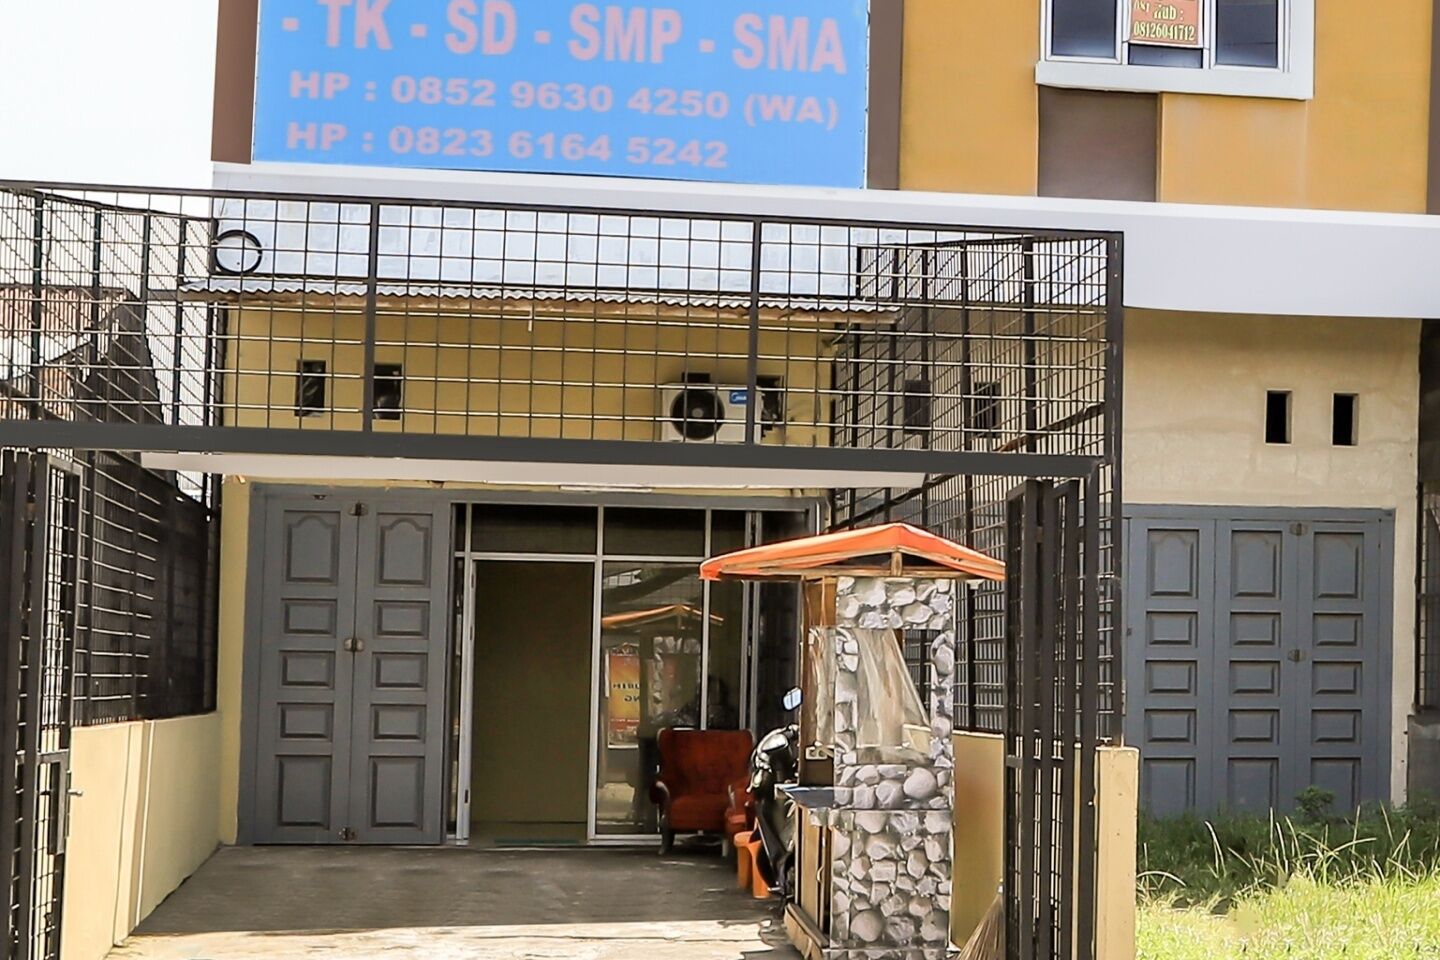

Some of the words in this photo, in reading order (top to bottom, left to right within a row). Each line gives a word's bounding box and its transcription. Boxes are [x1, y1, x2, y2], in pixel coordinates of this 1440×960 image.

[569, 2, 683, 64] SMP
[732, 14, 847, 73] SMA
[289, 70, 350, 100] HP
[391, 75, 496, 108] 0852
[511, 81, 612, 113] 9630
[628, 87, 729, 119] 4250
[743, 93, 838, 130] (WA)
[287, 122, 347, 151] HP
[389, 125, 494, 157] 0823
[508, 131, 611, 163] 6164
[626, 136, 728, 170] 5242
